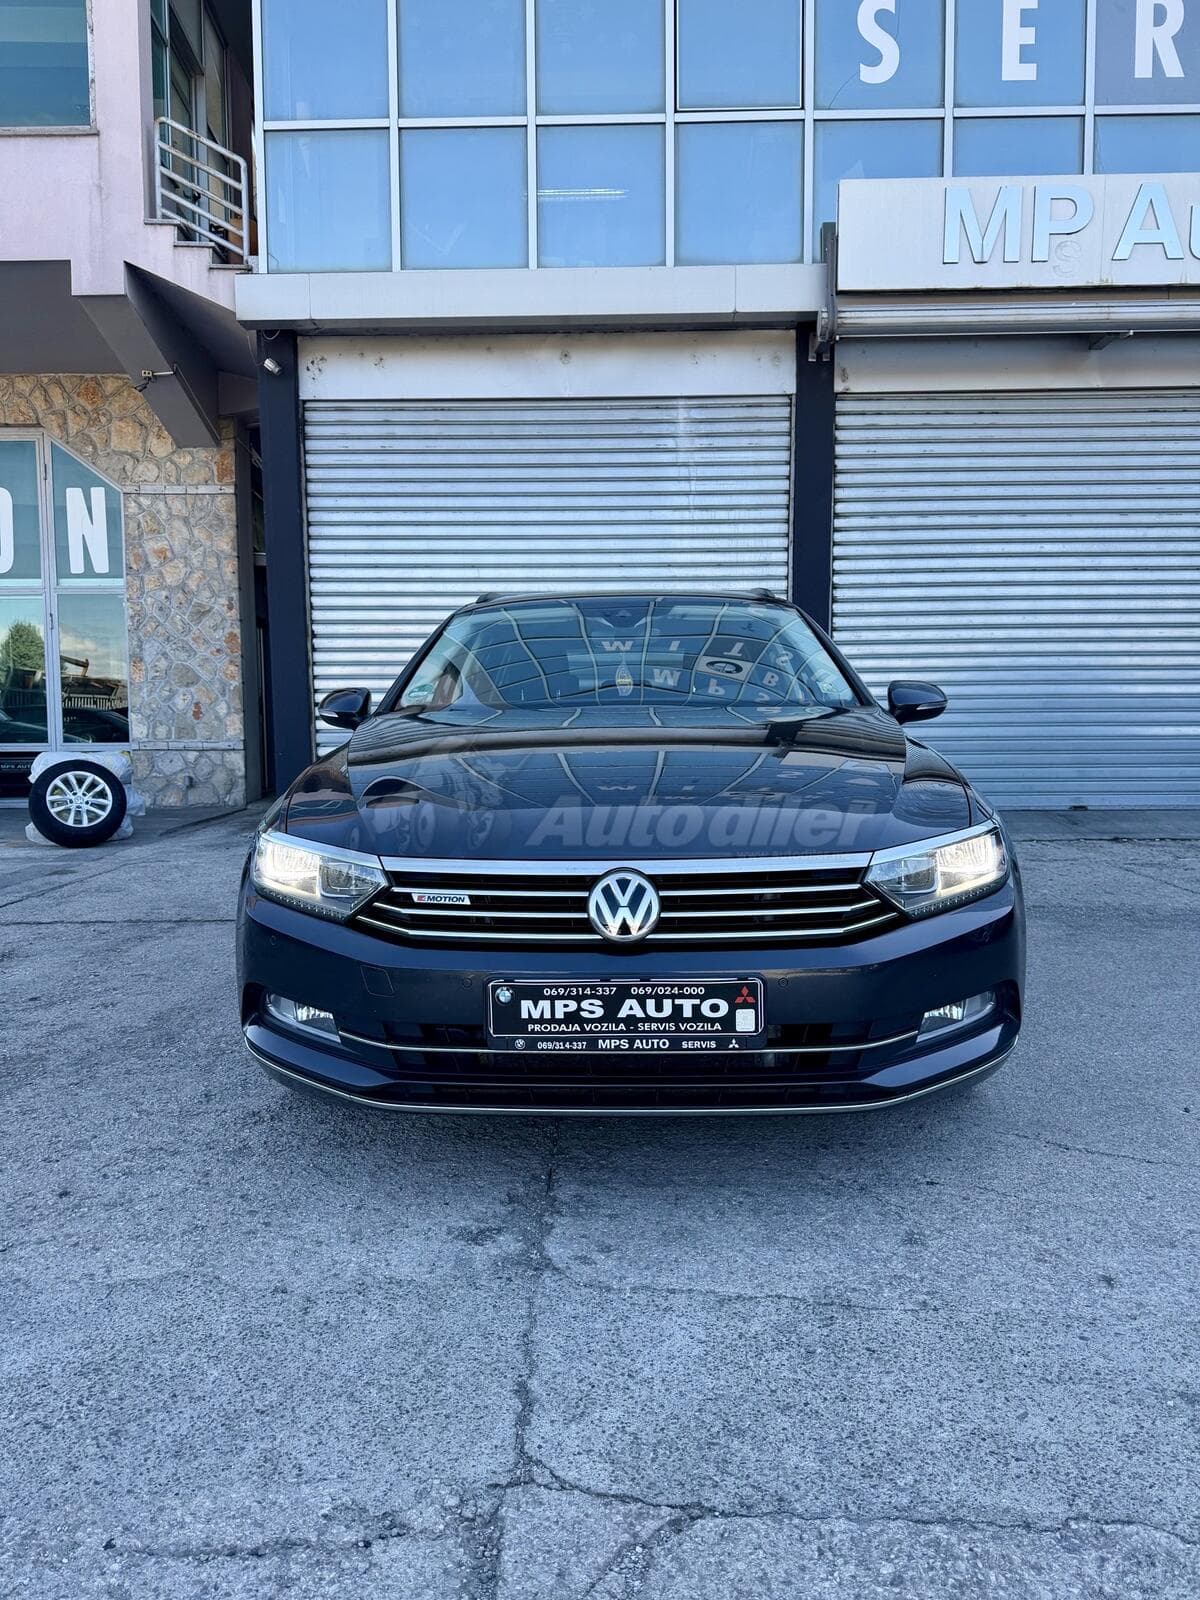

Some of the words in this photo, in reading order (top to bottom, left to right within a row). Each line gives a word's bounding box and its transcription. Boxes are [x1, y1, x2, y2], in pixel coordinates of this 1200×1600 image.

[1111, 181, 1200, 262] A
[543, 987, 617, 996] 069/314-337
[630, 986, 705, 995] 069/024-000
[520, 999, 605, 1019] MPS
[617, 998, 729, 1018] AUTO
[527, 1023, 581, 1032] PRODAJA
[583, 1023, 626, 1032] VOZILA
[637, 1022, 676, 1031] SERVIS
[678, 1022, 722, 1031] VOZILA
[537, 1041, 587, 1050] 069/314-337
[598, 1039, 629, 1049] MPS
[633, 1039, 670, 1049] AUTO
[681, 1040, 717, 1049] SERVIS
